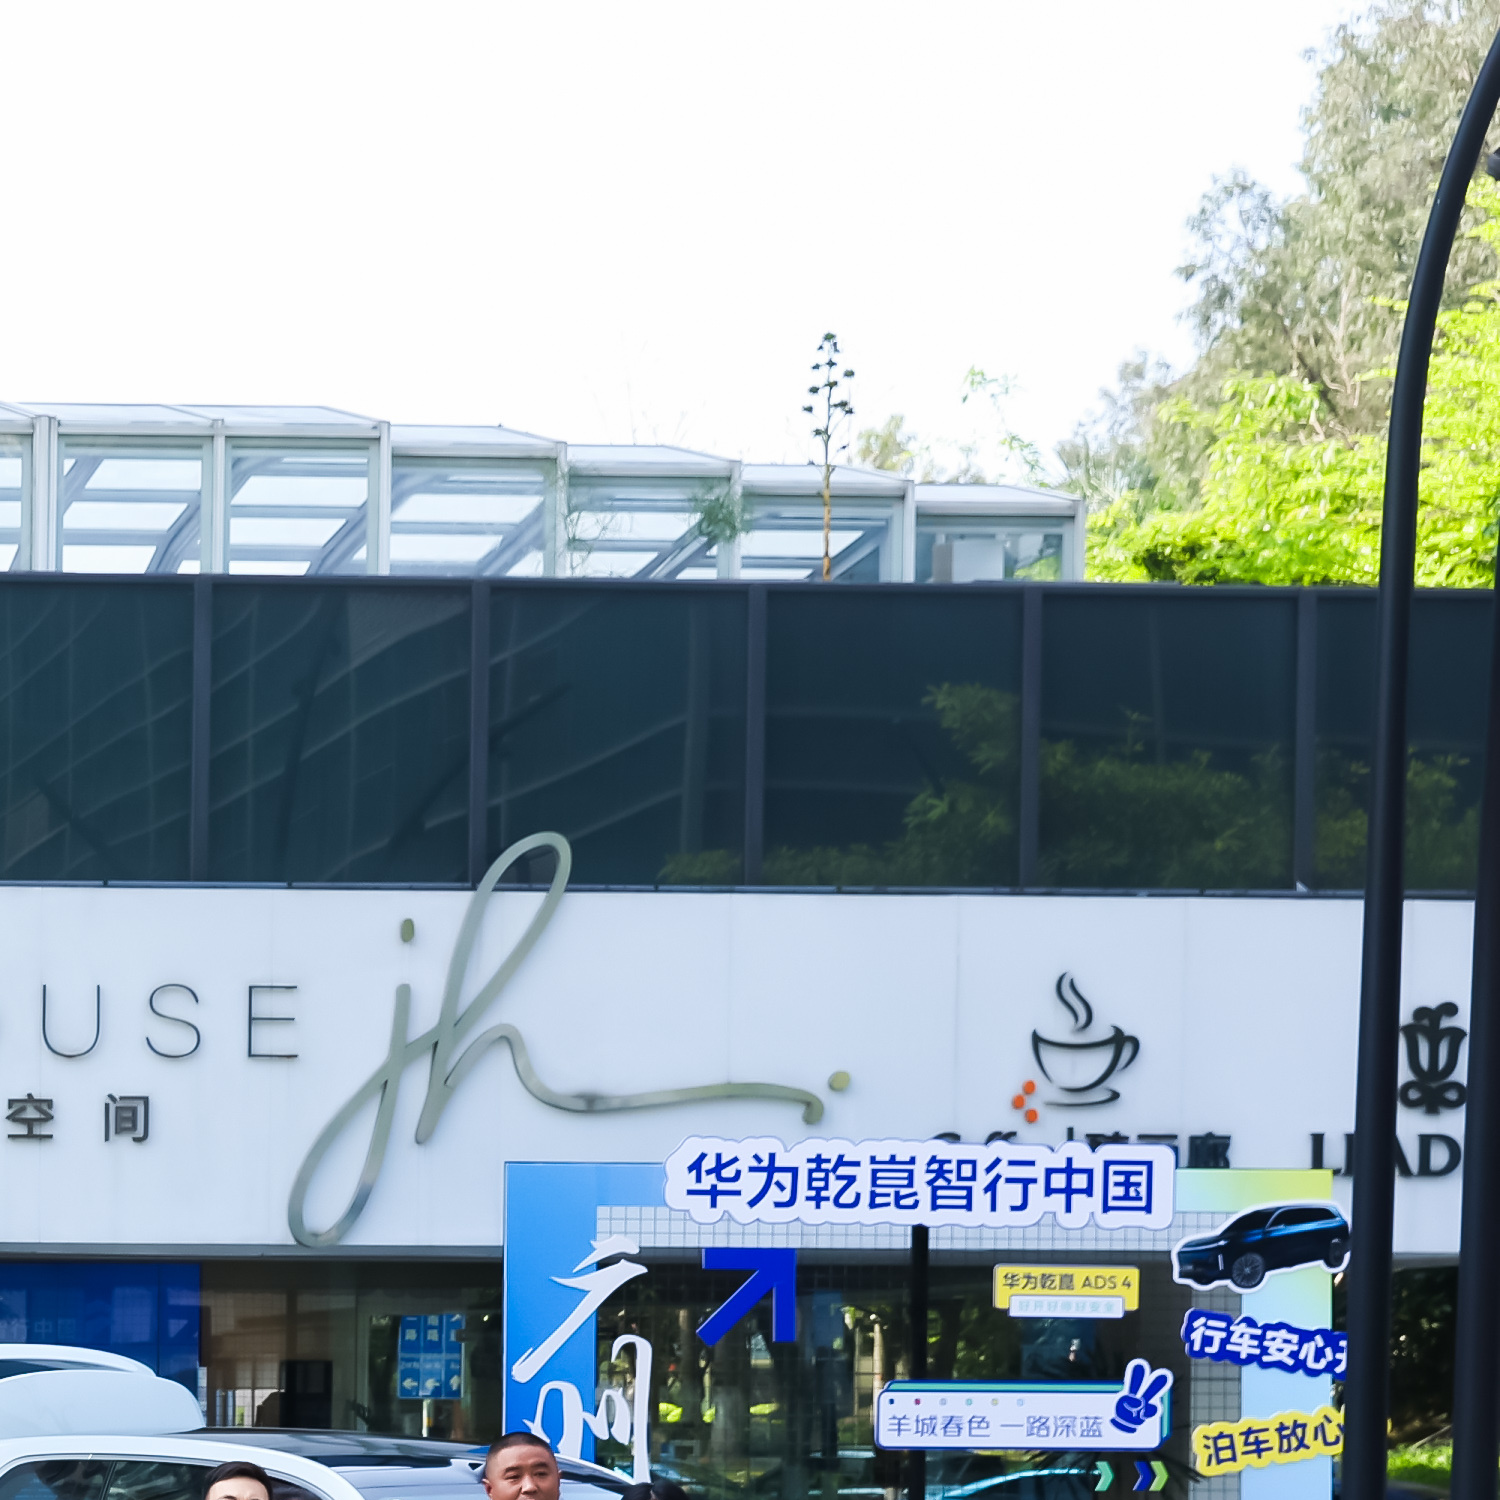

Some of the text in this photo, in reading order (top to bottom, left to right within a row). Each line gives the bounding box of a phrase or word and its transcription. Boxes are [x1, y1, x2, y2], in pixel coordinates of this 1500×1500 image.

[685, 1151, 1156, 1216] 华为乾崑智行中国
[1002, 1272, 1133, 1291] 华为乾崑 ADS 4
[886, 1415, 1104, 1439] 羊城春色 一路深蓝
